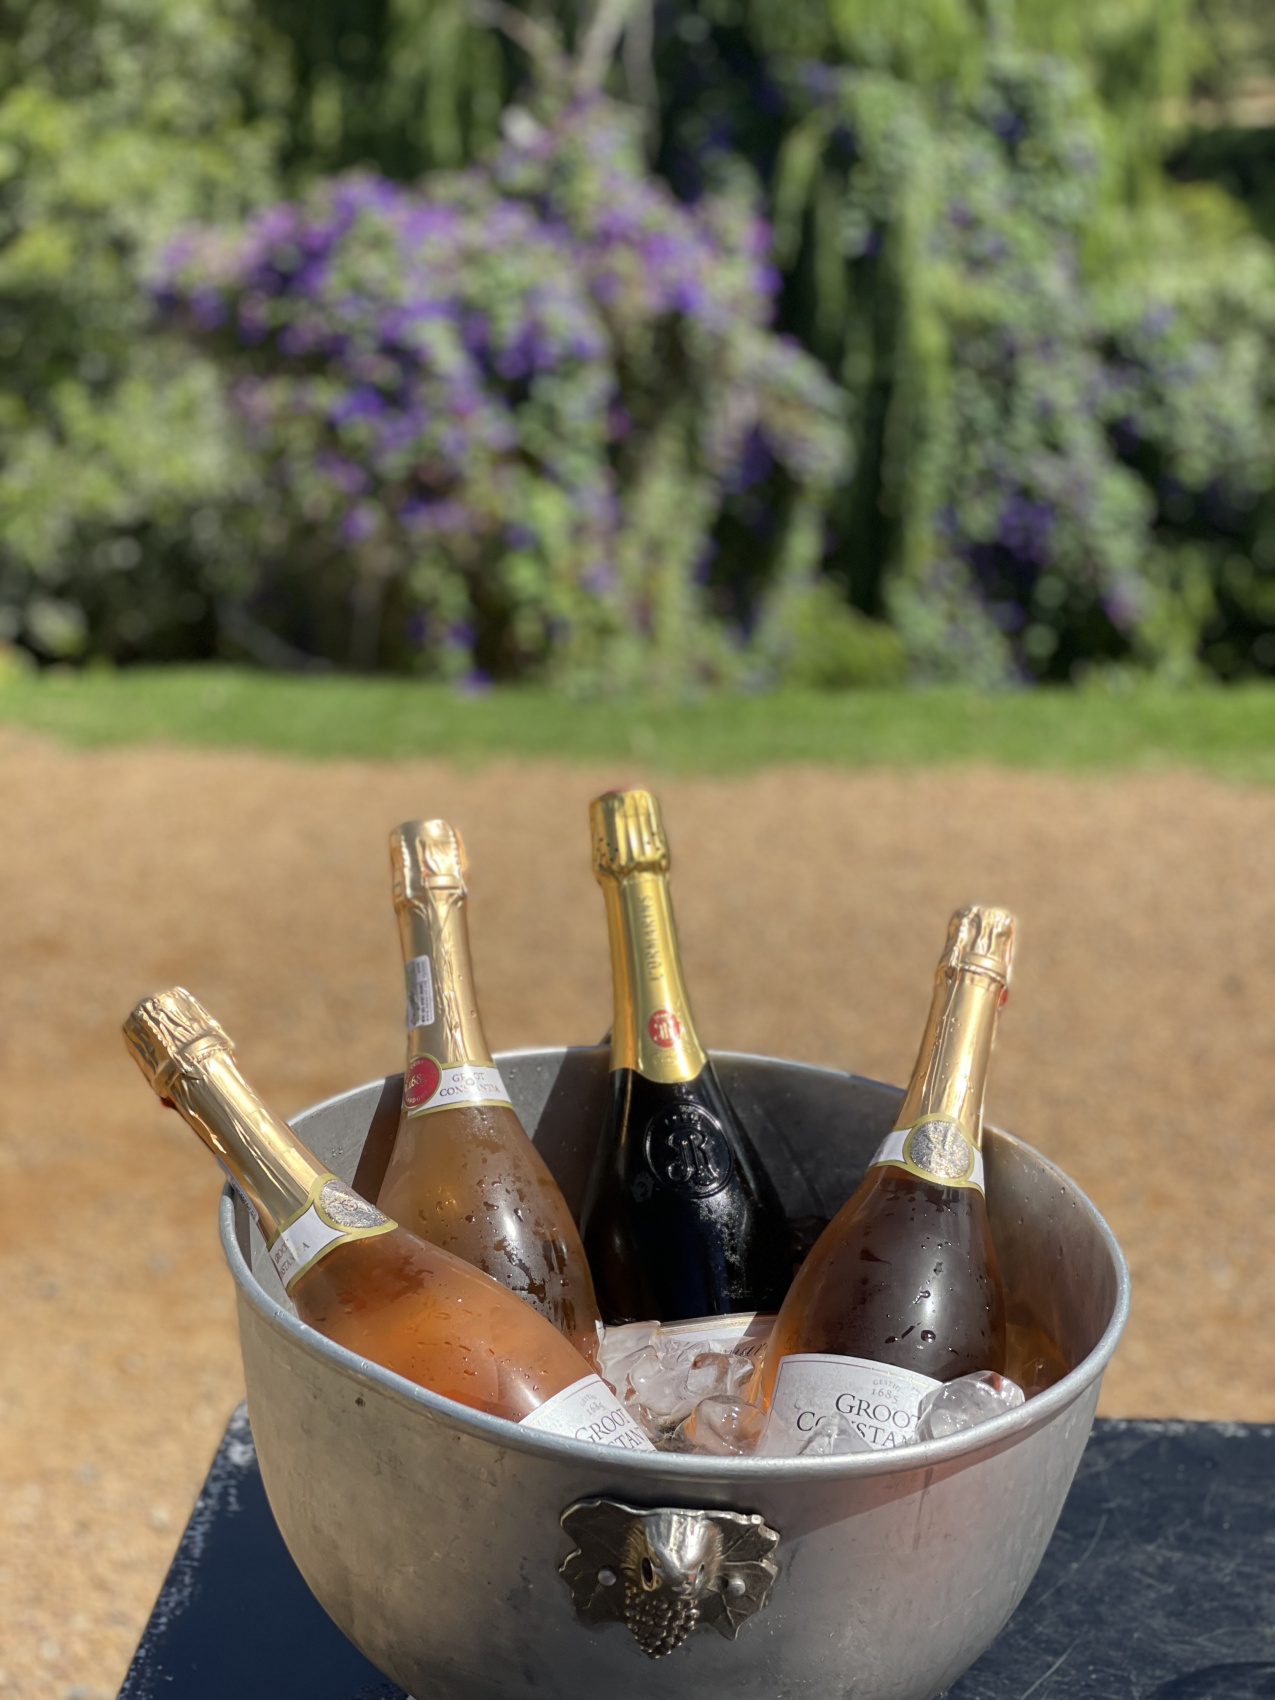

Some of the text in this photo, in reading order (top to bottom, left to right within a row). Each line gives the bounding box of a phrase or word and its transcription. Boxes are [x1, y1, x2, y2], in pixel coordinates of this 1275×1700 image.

[452, 1071, 485, 1083] GROT
[871, 1387, 899, 1404] 1685
[586, 1401, 607, 1416] 1685
